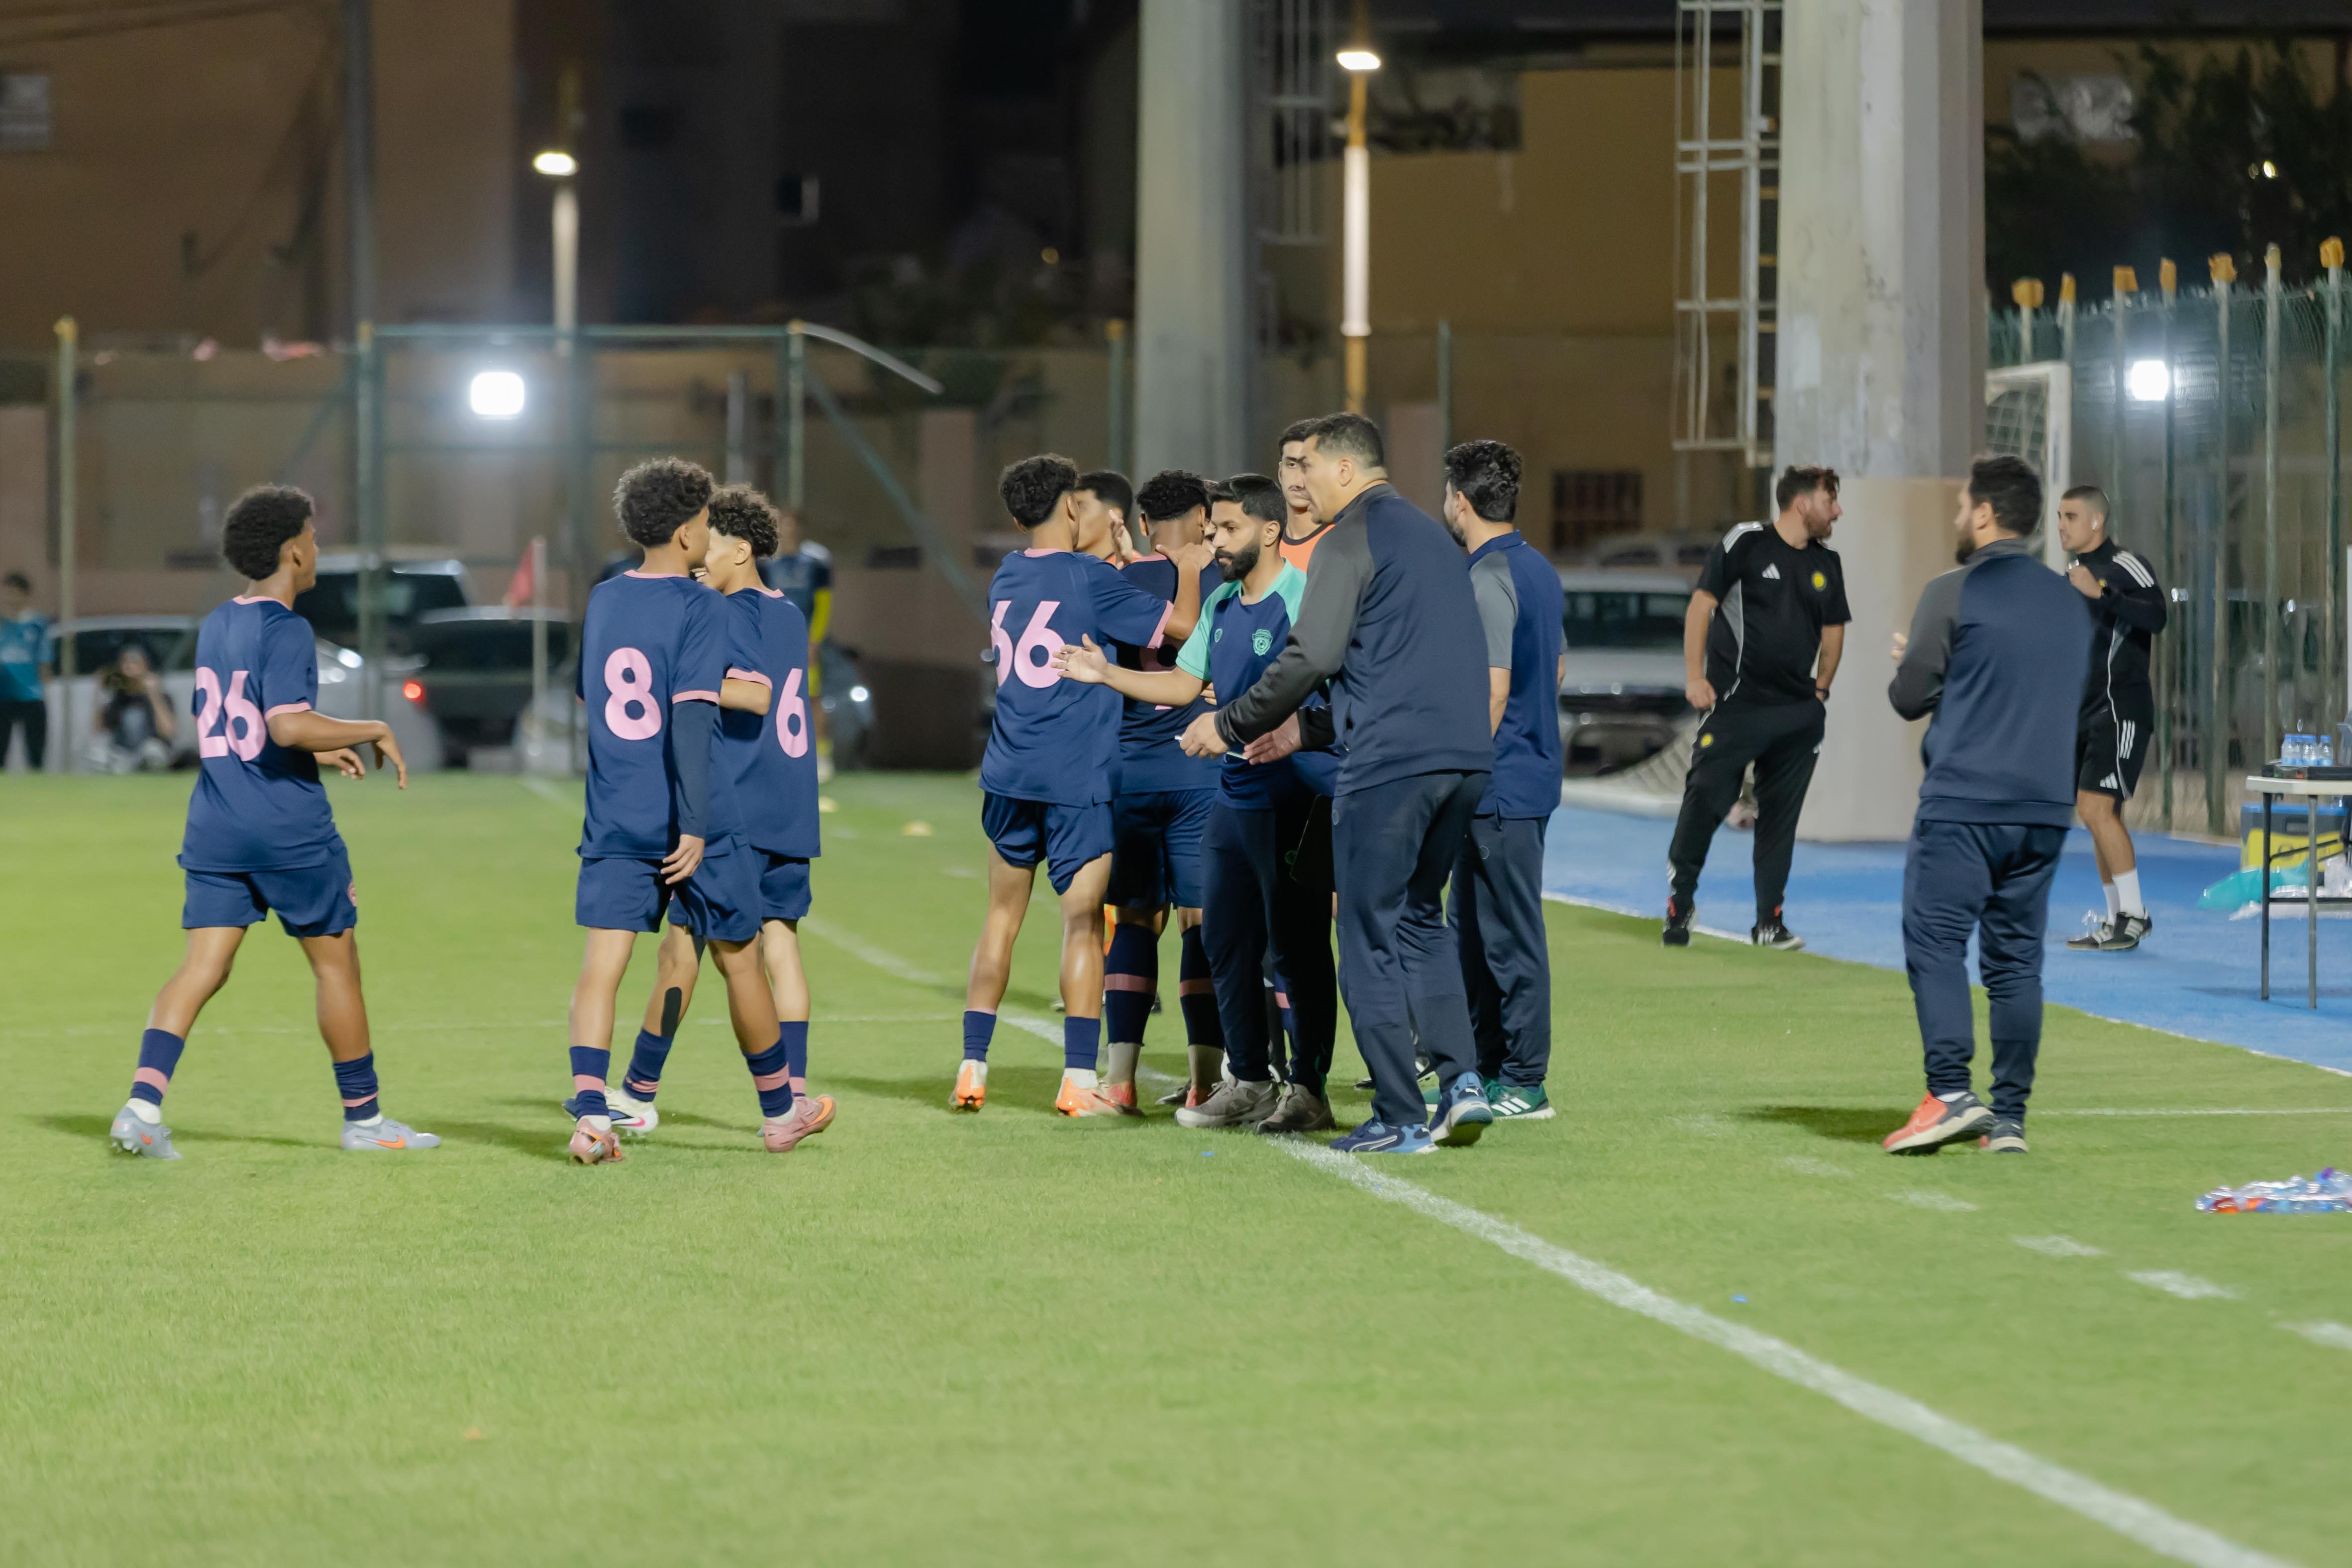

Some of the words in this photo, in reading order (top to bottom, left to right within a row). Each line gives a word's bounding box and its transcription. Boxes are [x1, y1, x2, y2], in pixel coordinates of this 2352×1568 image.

[195, 666, 267, 761] 26
[604, 647, 662, 740] 8
[776, 668, 809, 758] 6
